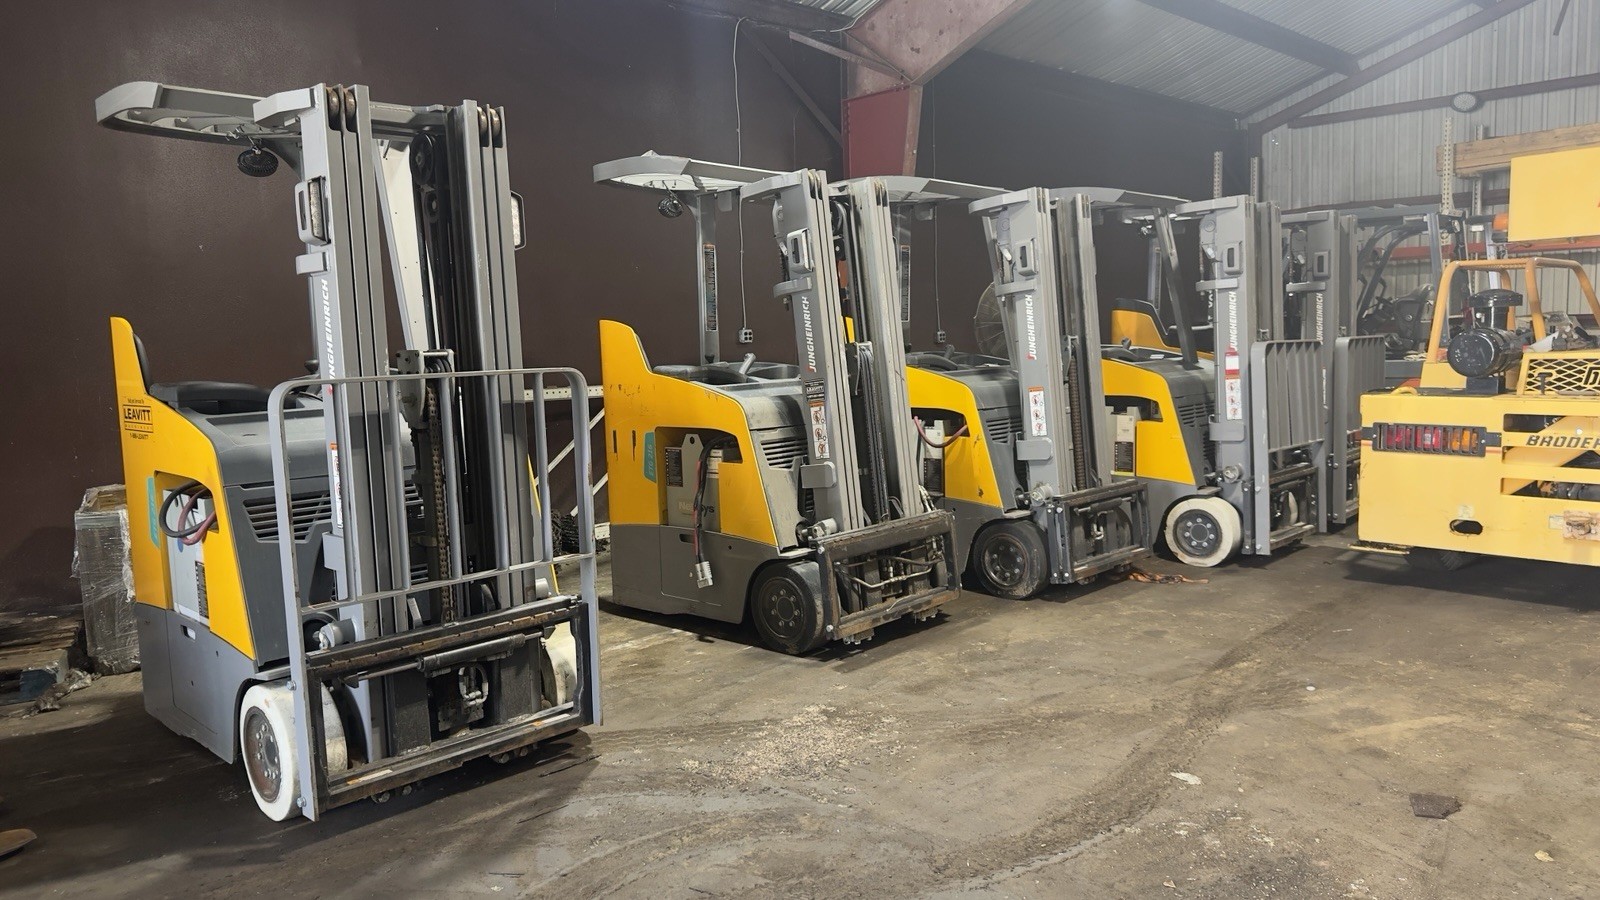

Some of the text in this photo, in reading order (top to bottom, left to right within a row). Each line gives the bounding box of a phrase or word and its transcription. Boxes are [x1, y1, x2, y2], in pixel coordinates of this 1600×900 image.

[321, 279, 336, 386] NGHEINRICH
[801, 296, 818, 373] JUNGHEINRICH
[1024, 294, 1038, 361] JUNGHEINRICH
[1228, 291, 1238, 353] JUNGHEINRICH
[123, 408, 151, 421] LEAVITT
[678, 501, 715, 517] Neys
